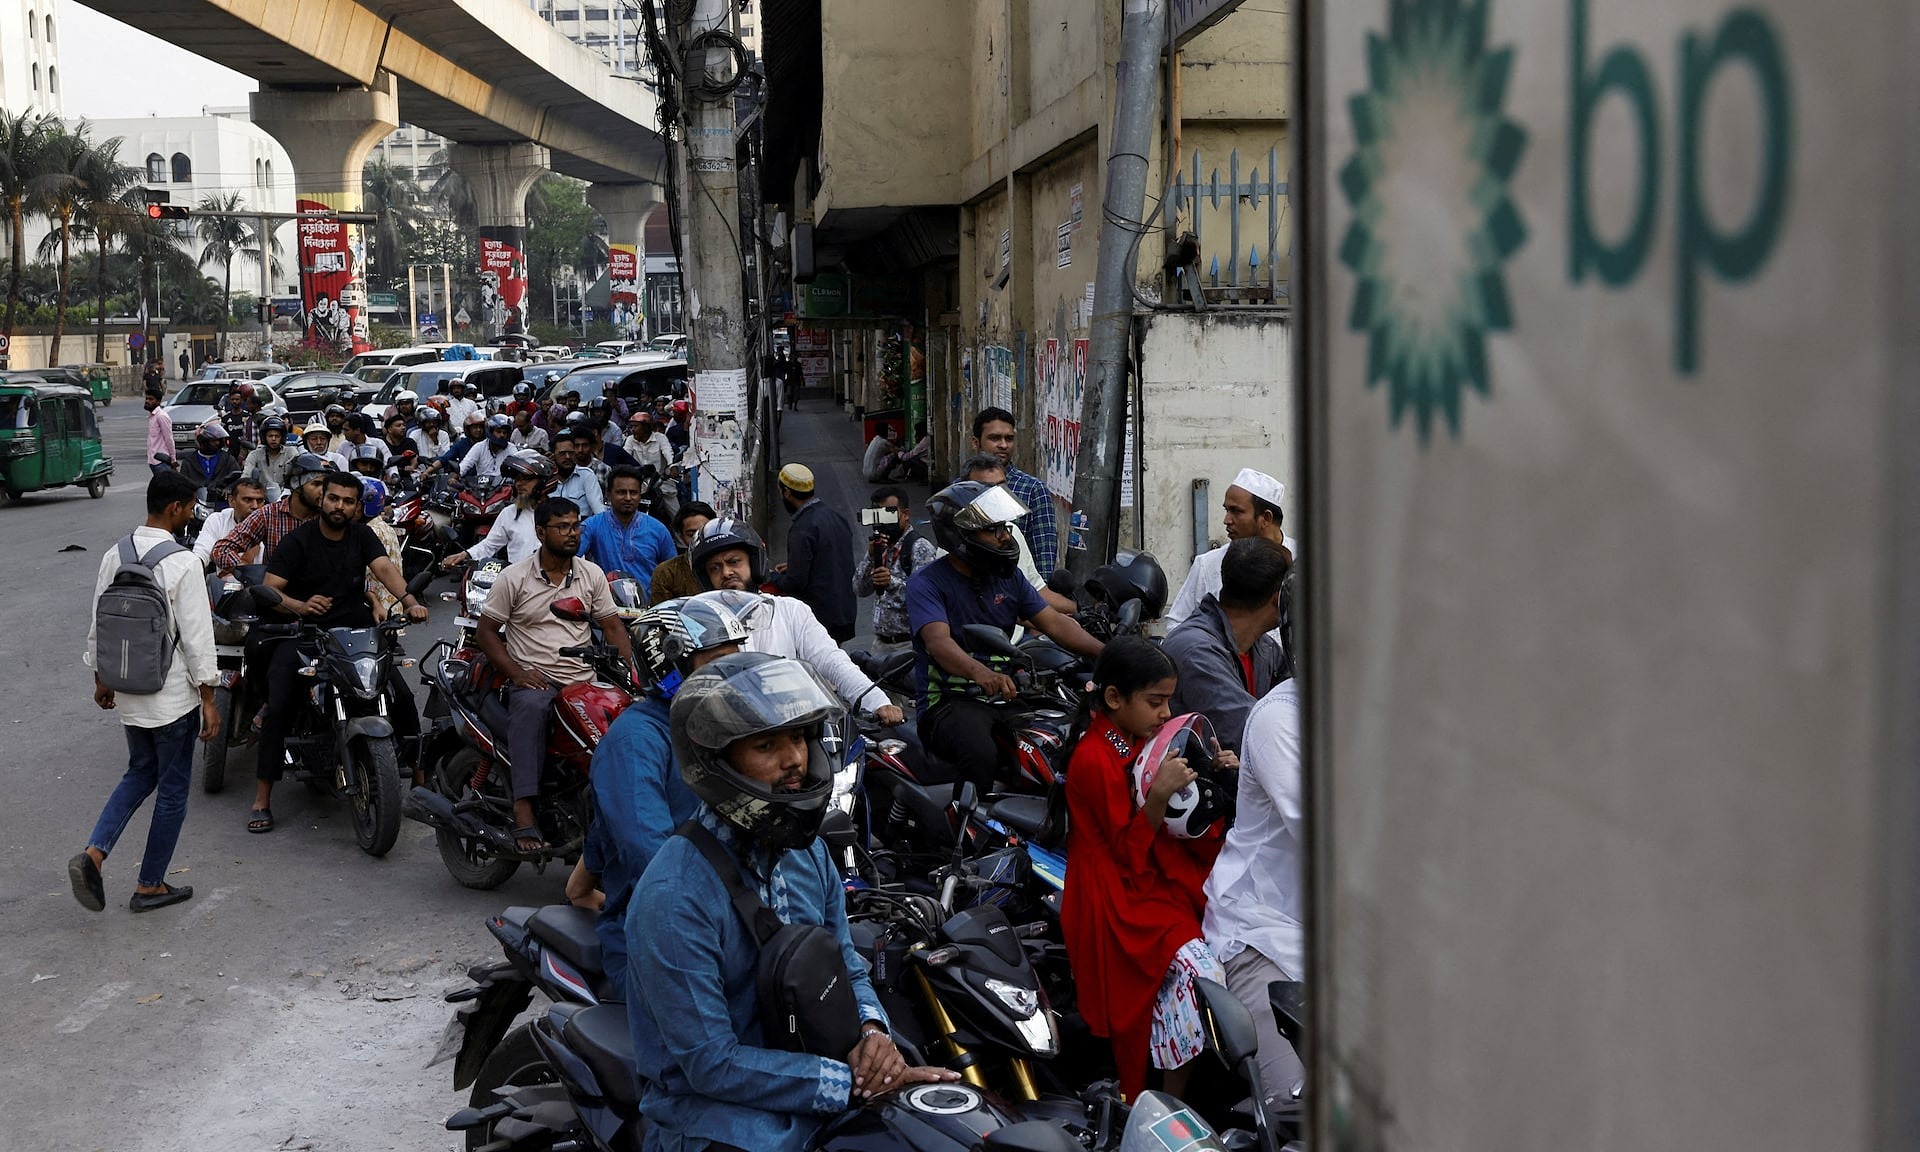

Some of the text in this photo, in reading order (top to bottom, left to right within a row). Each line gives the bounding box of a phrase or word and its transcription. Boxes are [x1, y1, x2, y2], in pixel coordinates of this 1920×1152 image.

[1568, 0, 1795, 377] bp
[1019, 740, 1035, 754] TVS
[988, 925, 1009, 935] HONDA
